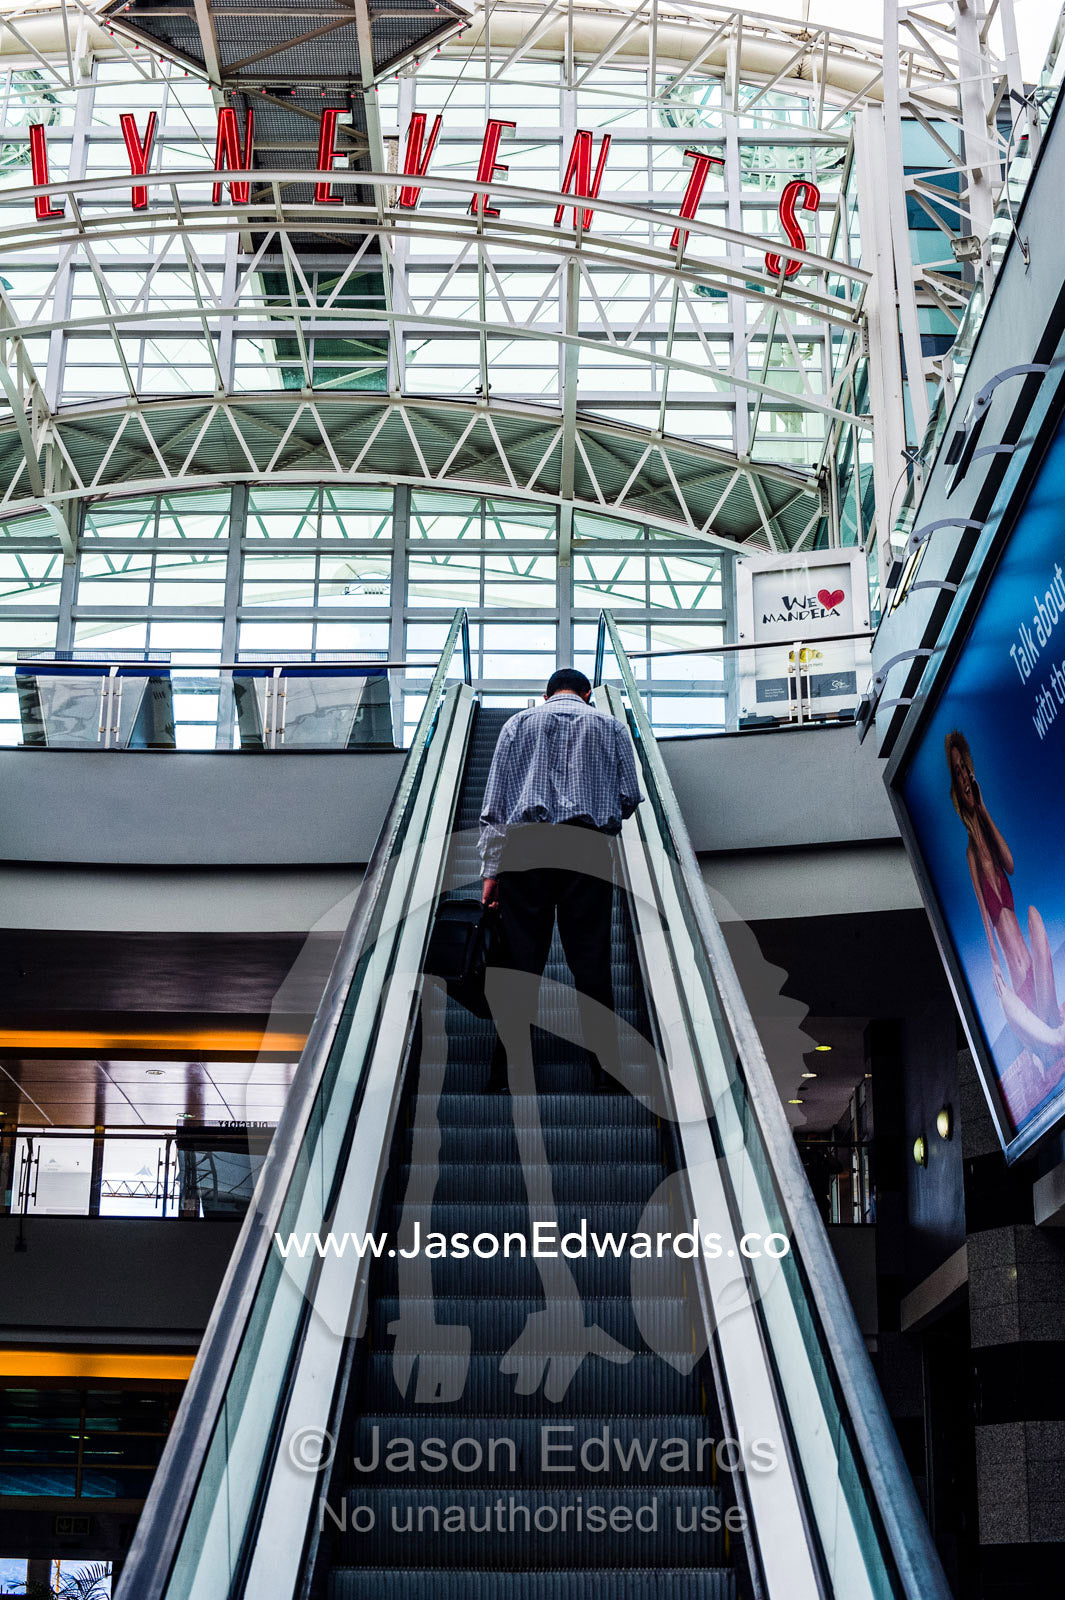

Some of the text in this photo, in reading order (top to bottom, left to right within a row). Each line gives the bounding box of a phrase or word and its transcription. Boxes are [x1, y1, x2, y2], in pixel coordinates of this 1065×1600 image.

[762, 607, 841, 624] MANDELA
[781, 595, 816, 611] WE
[1010, 622, 1040, 685] Talk
[1032, 683, 1058, 740] with
